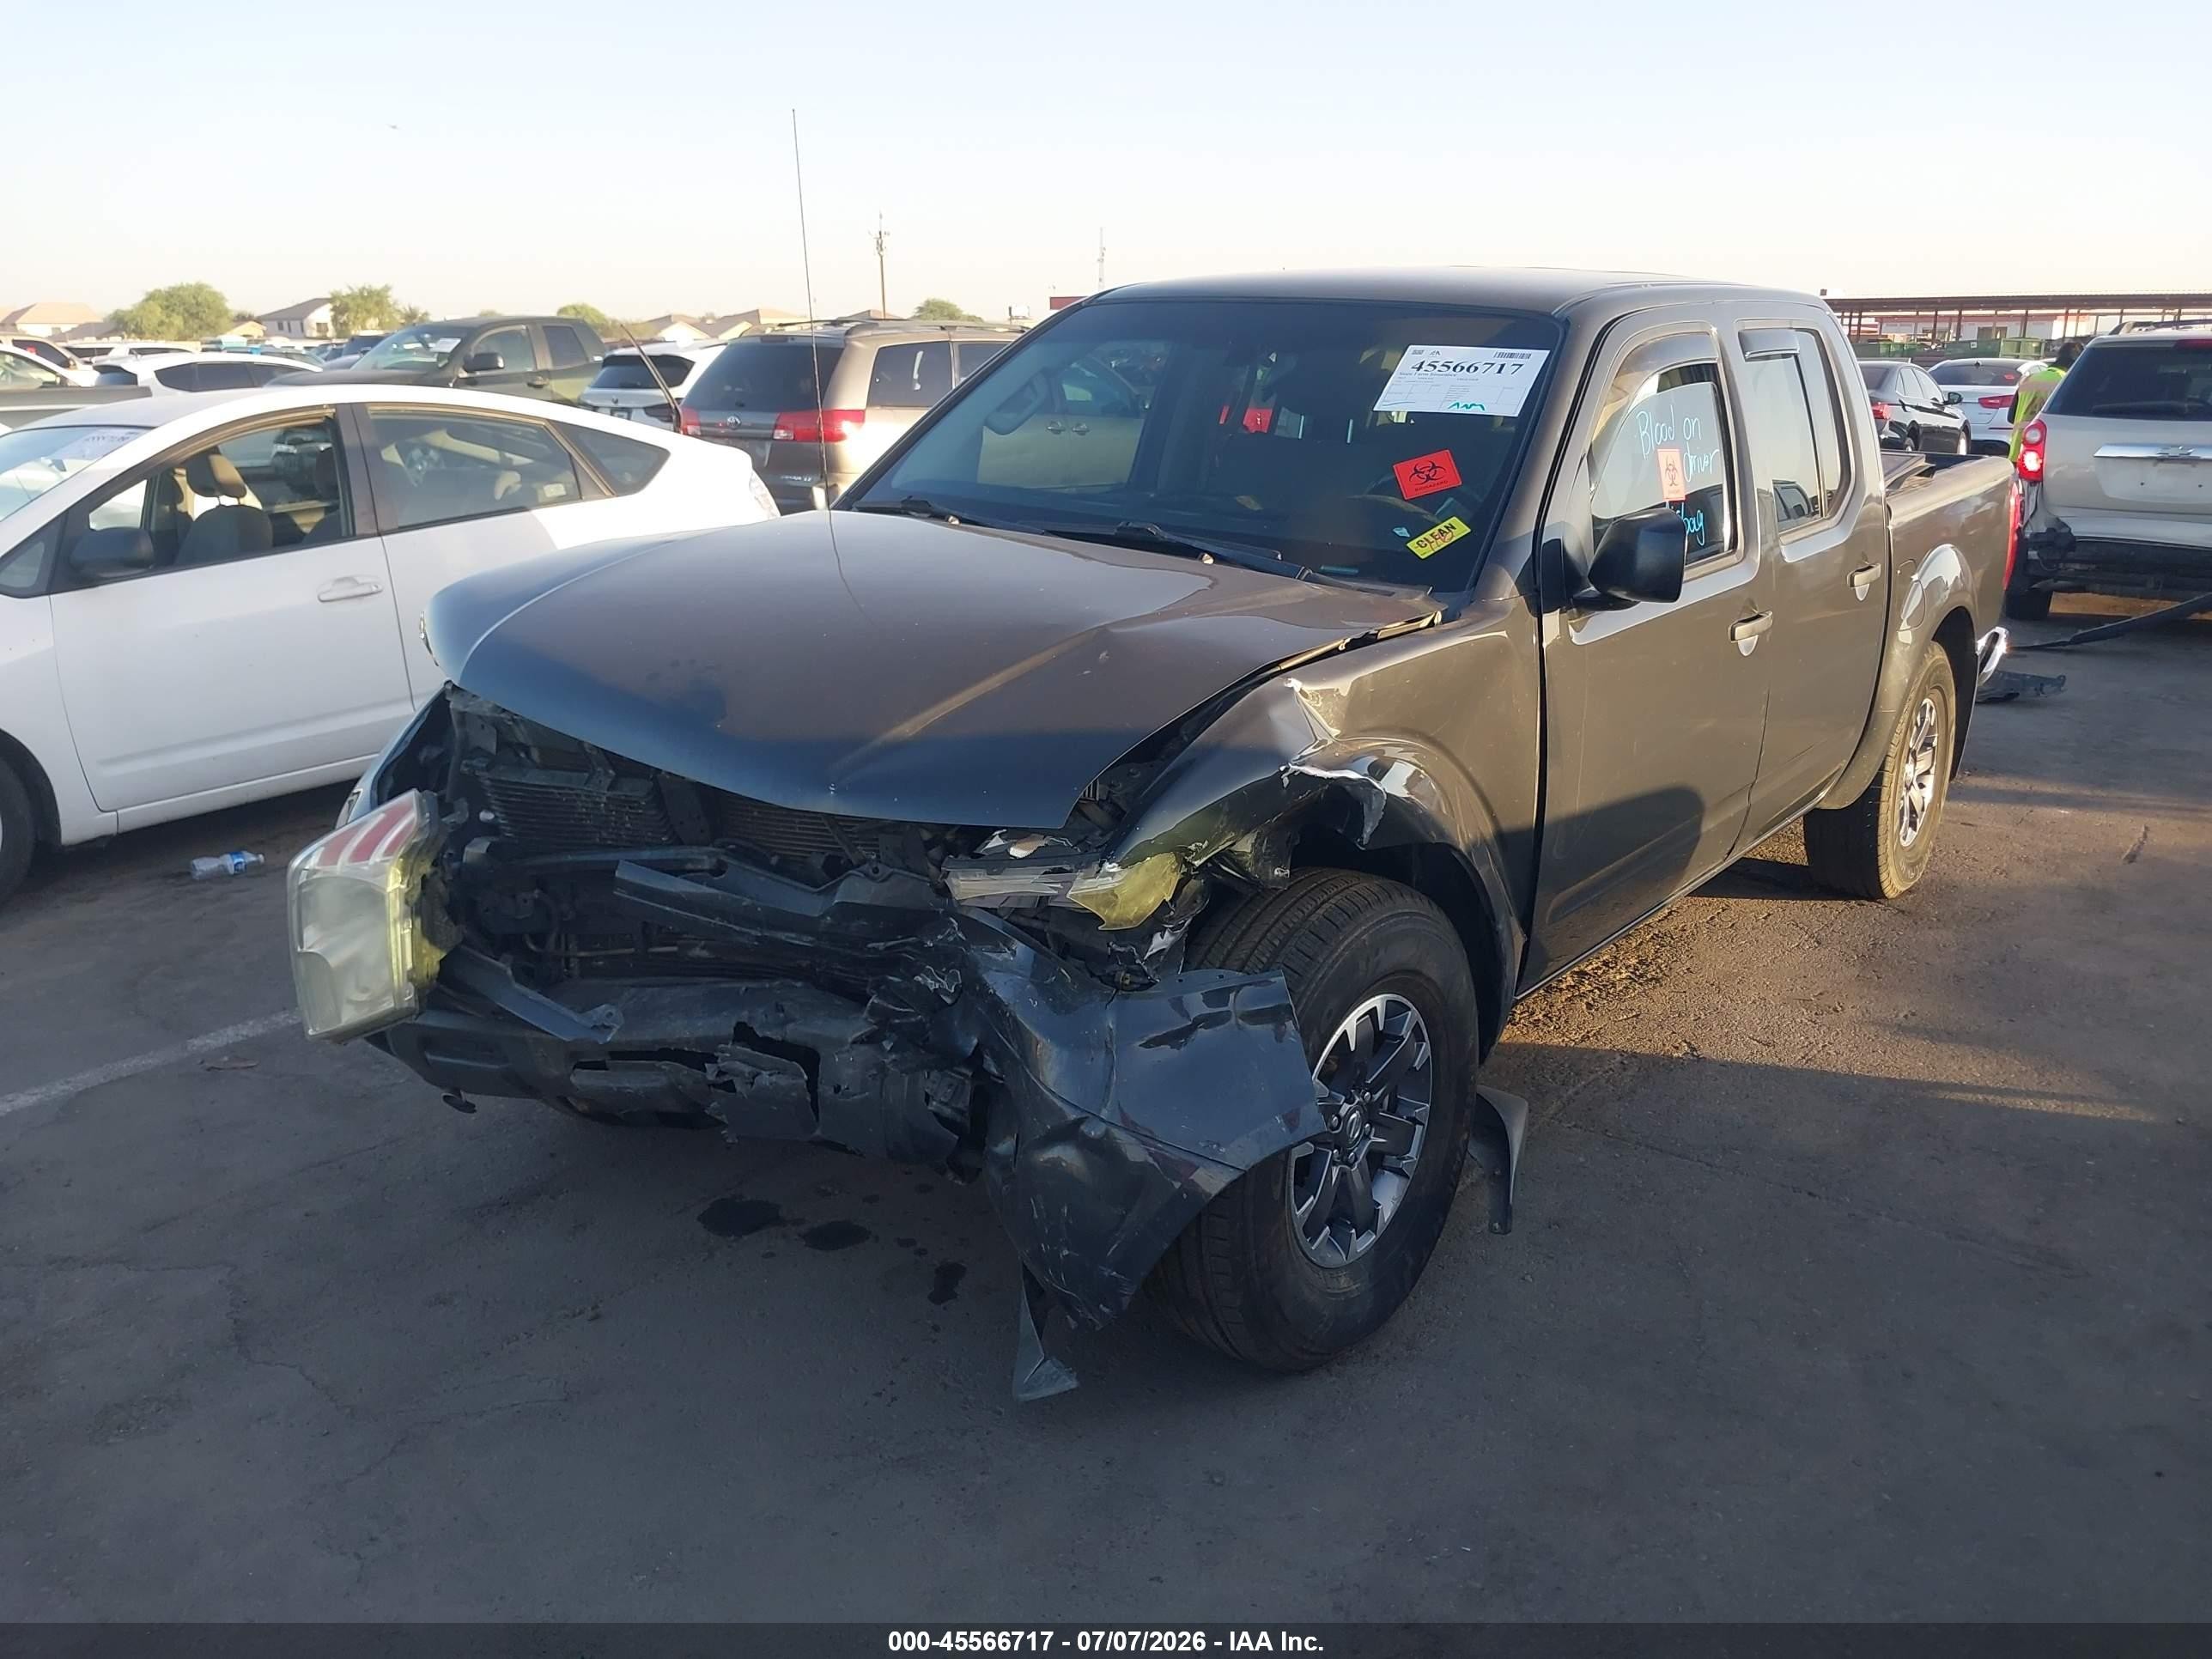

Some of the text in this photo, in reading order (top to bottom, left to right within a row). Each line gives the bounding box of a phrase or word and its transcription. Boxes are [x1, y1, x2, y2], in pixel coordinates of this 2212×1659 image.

[1411, 361, 1524, 375] 45566717
[1636, 404, 1701, 459] Blood on
[1683, 442, 1719, 482] driver
[1416, 523, 1457, 548] CLEAN
